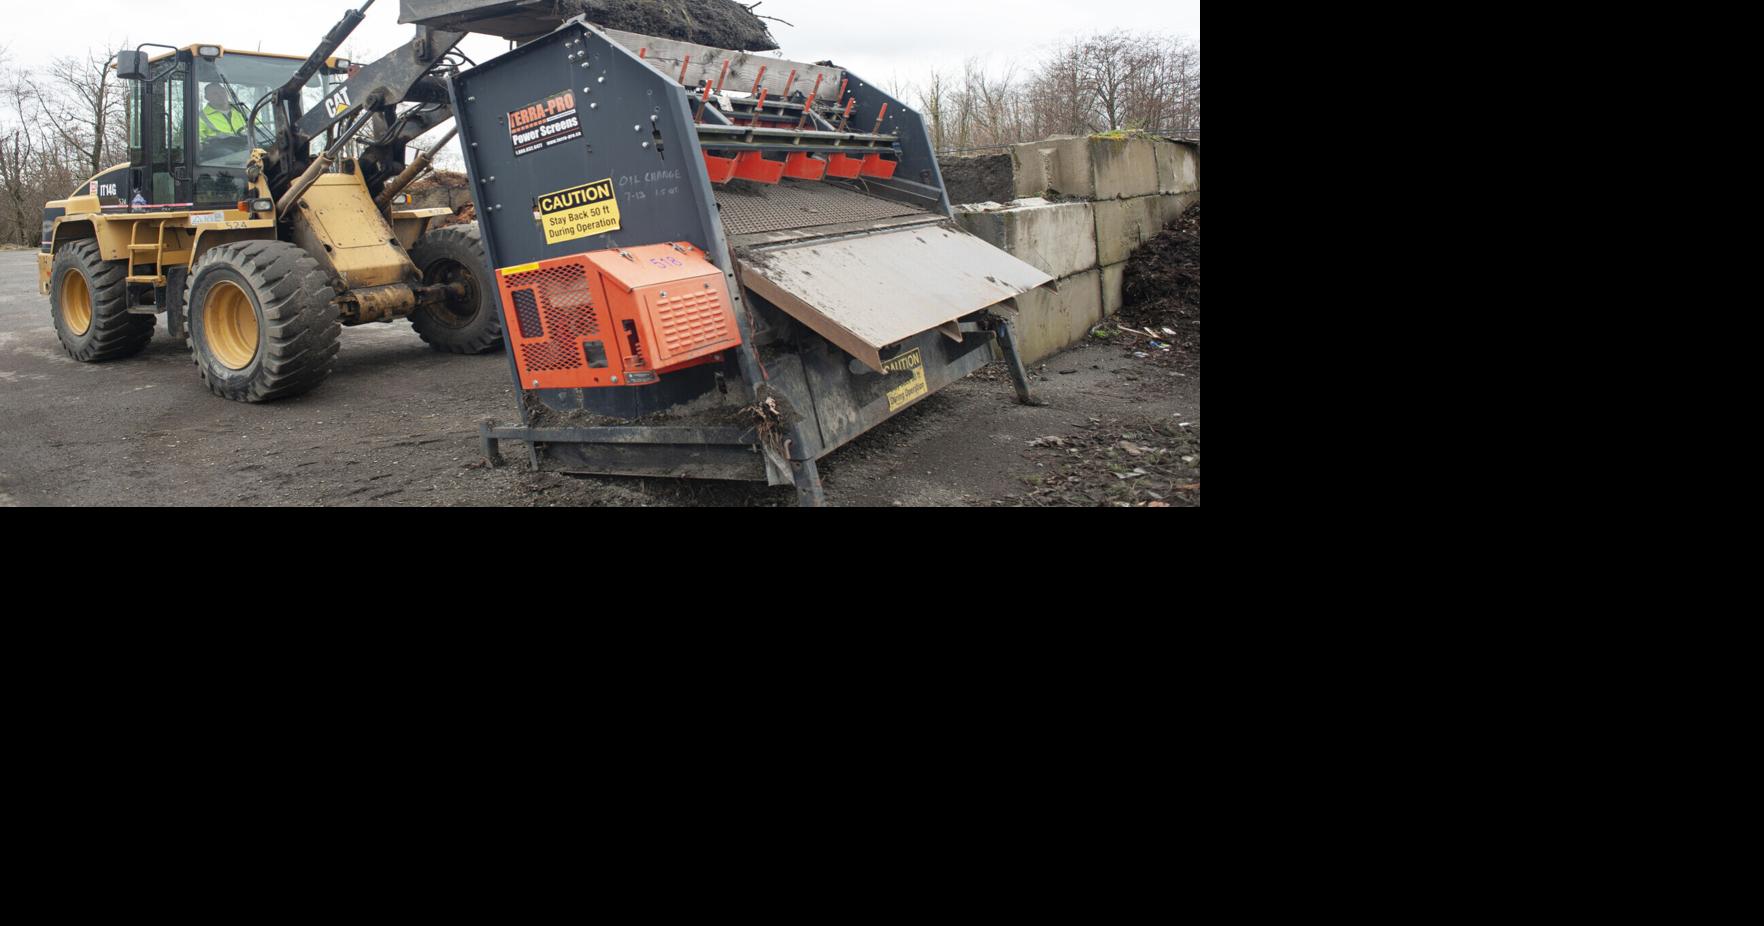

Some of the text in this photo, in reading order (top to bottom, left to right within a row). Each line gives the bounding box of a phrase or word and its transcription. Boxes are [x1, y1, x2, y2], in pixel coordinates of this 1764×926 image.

[325, 86, 351, 118] CAT
[510, 93, 575, 128] TERRA-PRO
[512, 117, 578, 146] Power Screens
[619, 169, 680, 186] OIL CHANGE
[542, 184, 610, 211] CAUTION
[549, 205, 610, 226] Stay Back 50 ft
[549, 218, 617, 238] During Operation
